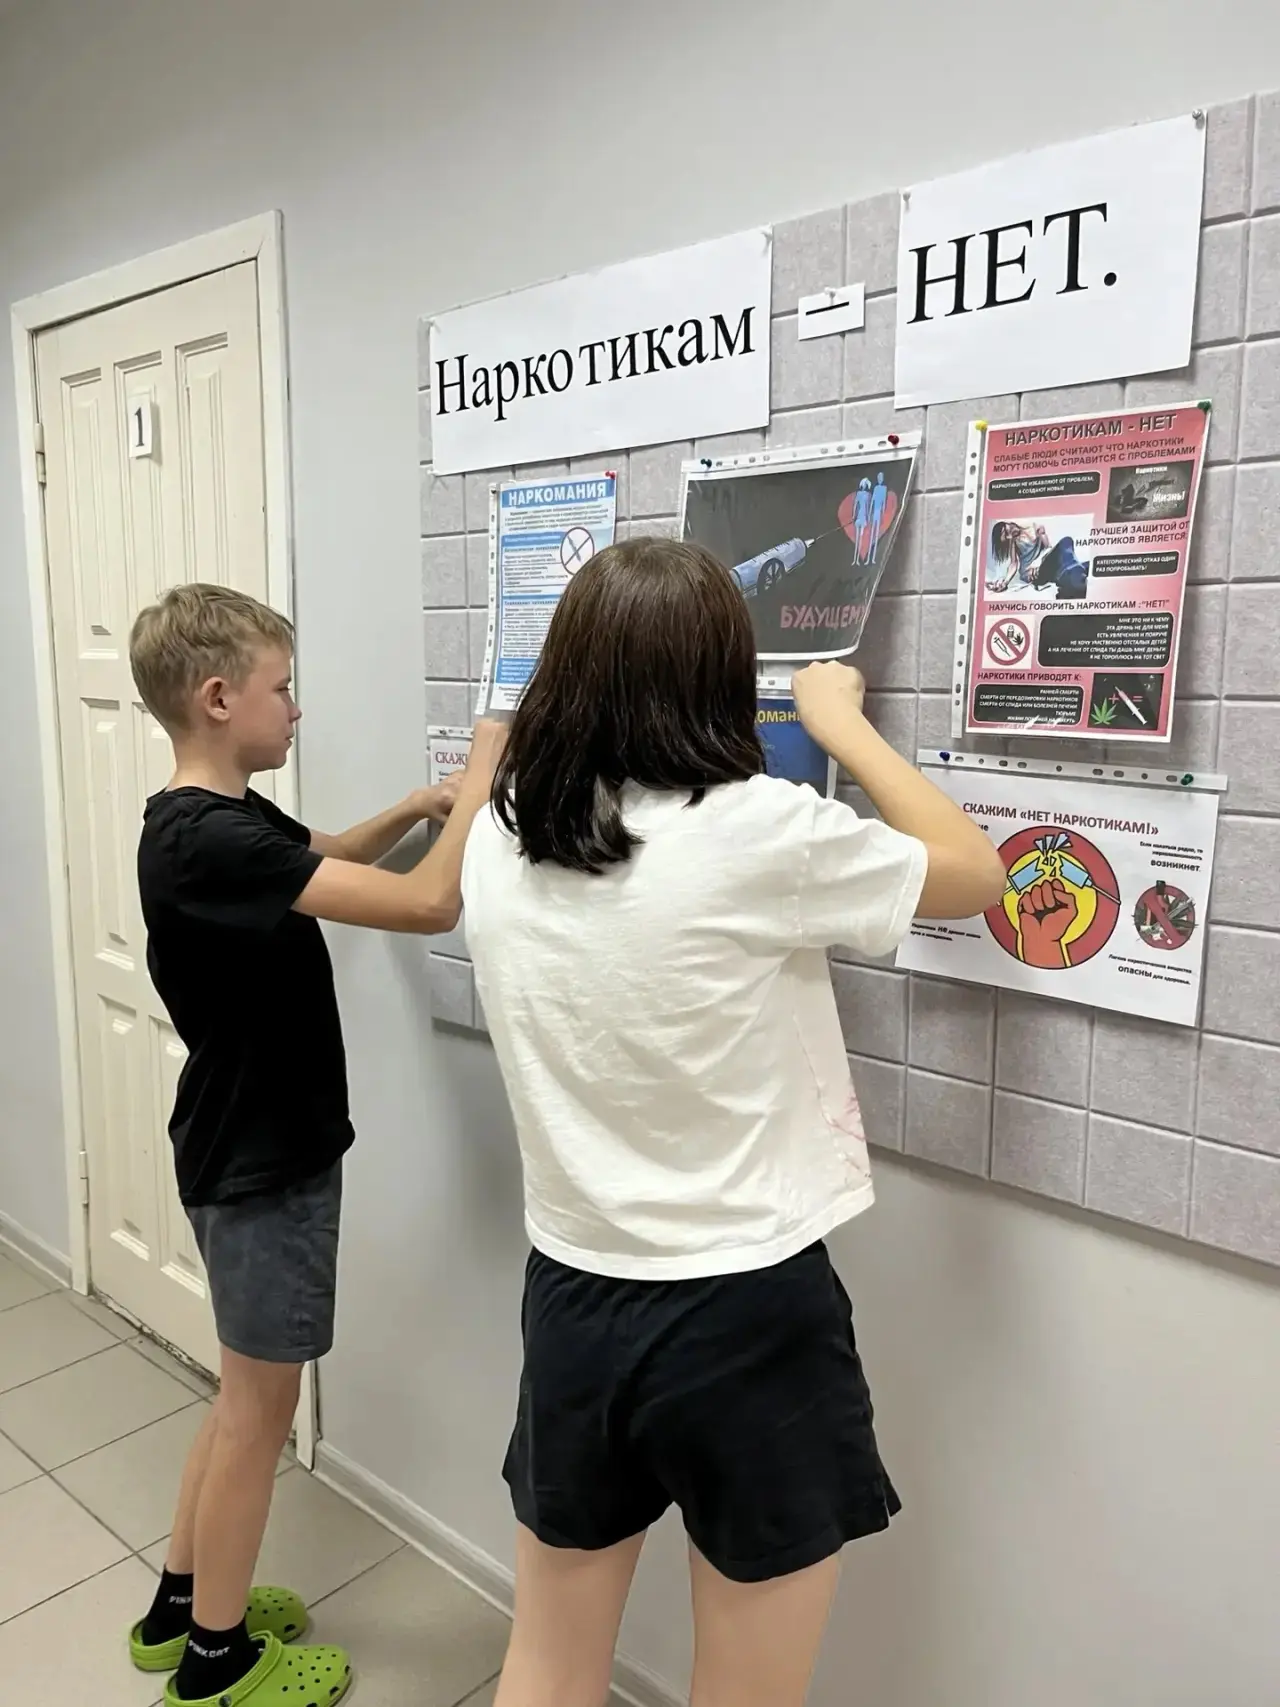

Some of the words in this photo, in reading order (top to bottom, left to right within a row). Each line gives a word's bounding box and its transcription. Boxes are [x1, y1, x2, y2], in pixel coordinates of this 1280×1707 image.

[435, 306, 756, 422] Наркотикам
[906, 202, 1117, 324] НЕТ.
[134, 406, 144, 447] 1
[1005, 419, 1123, 447] НАРКОТИКАМ
[1139, 413, 1177, 433] НЕТ
[993, 463, 1020, 472] МОГУТ
[1022, 460, 1059, 470] ПОМОЧЬ
[1061, 454, 1116, 466] СПРАВИТСЯ
[1118, 453, 1126, 461] С
[1127, 446, 1196, 460] ПРОБЛЕМАМИ
[994, 452, 1030, 463] СЛАБЫЕ
[1032, 449, 1058, 460] ЛЮДИ
[1060, 445, 1103, 456] СЧИТАЮТ
[1106, 443, 1124, 452] ЧТО
[1127, 437, 1184, 450] НАРКОТИКИ
[508, 482, 607, 506] НАРКОМАНИЯ
[1090, 526, 1128, 536] ЛУЧШЕЙ
[1130, 521, 1177, 533] ЗАЩИТОЙ
[1178, 520, 1189, 529] ОТ
[1075, 537, 1135, 547] НАРКОТИКОВ
[989, 603, 1027, 611] НАУЧИСЬ
[1029, 602, 1074, 611] ГОВОРИТЬ
[1076, 601, 1136, 610] НАРКОТИКАМ
[977, 672, 1025, 680] НАРКОТИКИ
[1027, 673, 1072, 682] ПРИВОДЯТ
[963, 802, 1017, 819] СКАЖИМ
[1020, 809, 1050, 823] «НЕТ
[1053, 812, 1159, 836] НАРКОТИКАМ!»
[1118, 965, 1152, 978] опасны
